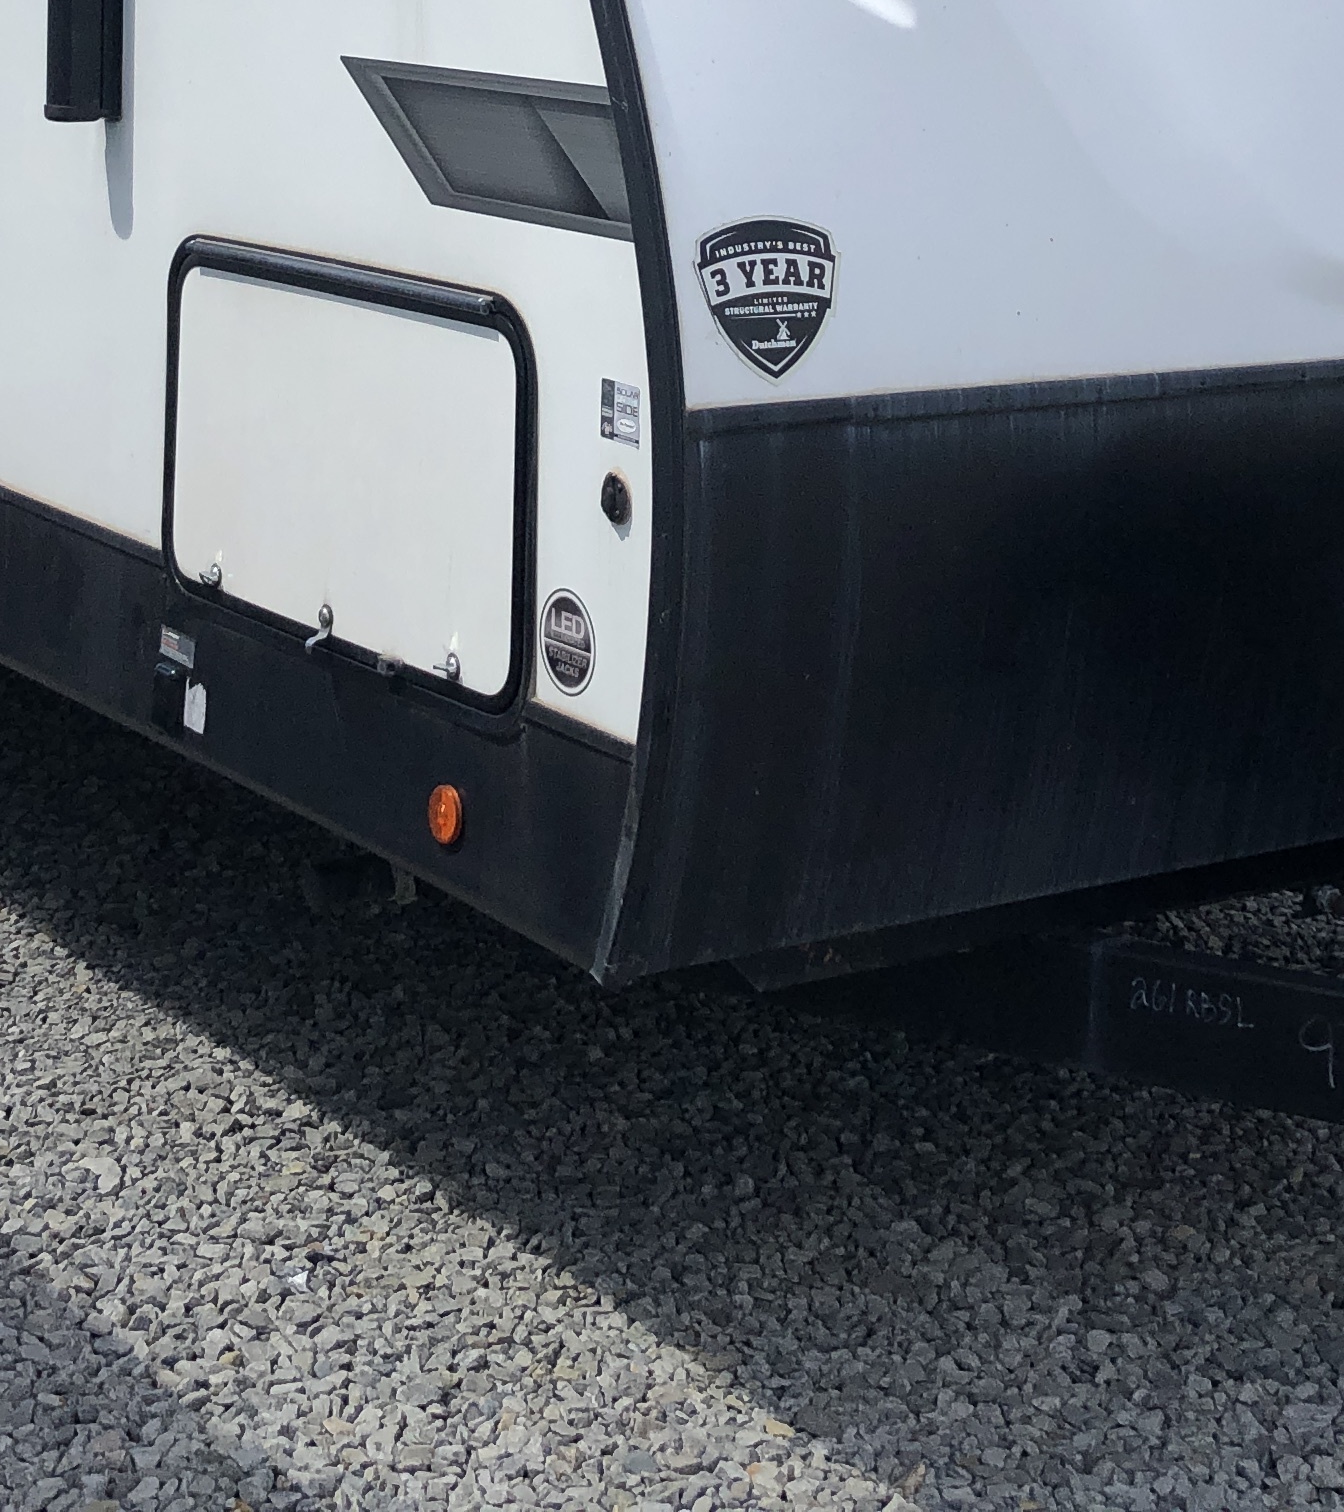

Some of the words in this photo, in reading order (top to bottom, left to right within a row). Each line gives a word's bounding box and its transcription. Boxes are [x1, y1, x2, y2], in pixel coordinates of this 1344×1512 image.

[715, 241, 783, 258] INDUSTRY'S
[788, 241, 816, 252] BEST
[709, 267, 731, 298] 3
[736, 257, 826, 291] YEAR
[724, 304, 774, 316] STRUCTURAL
[775, 301, 818, 313] WARRANTY
[753, 296, 788, 305] LIMITED
[550, 607, 586, 640] LED
[555, 660, 580, 678] JACKS
